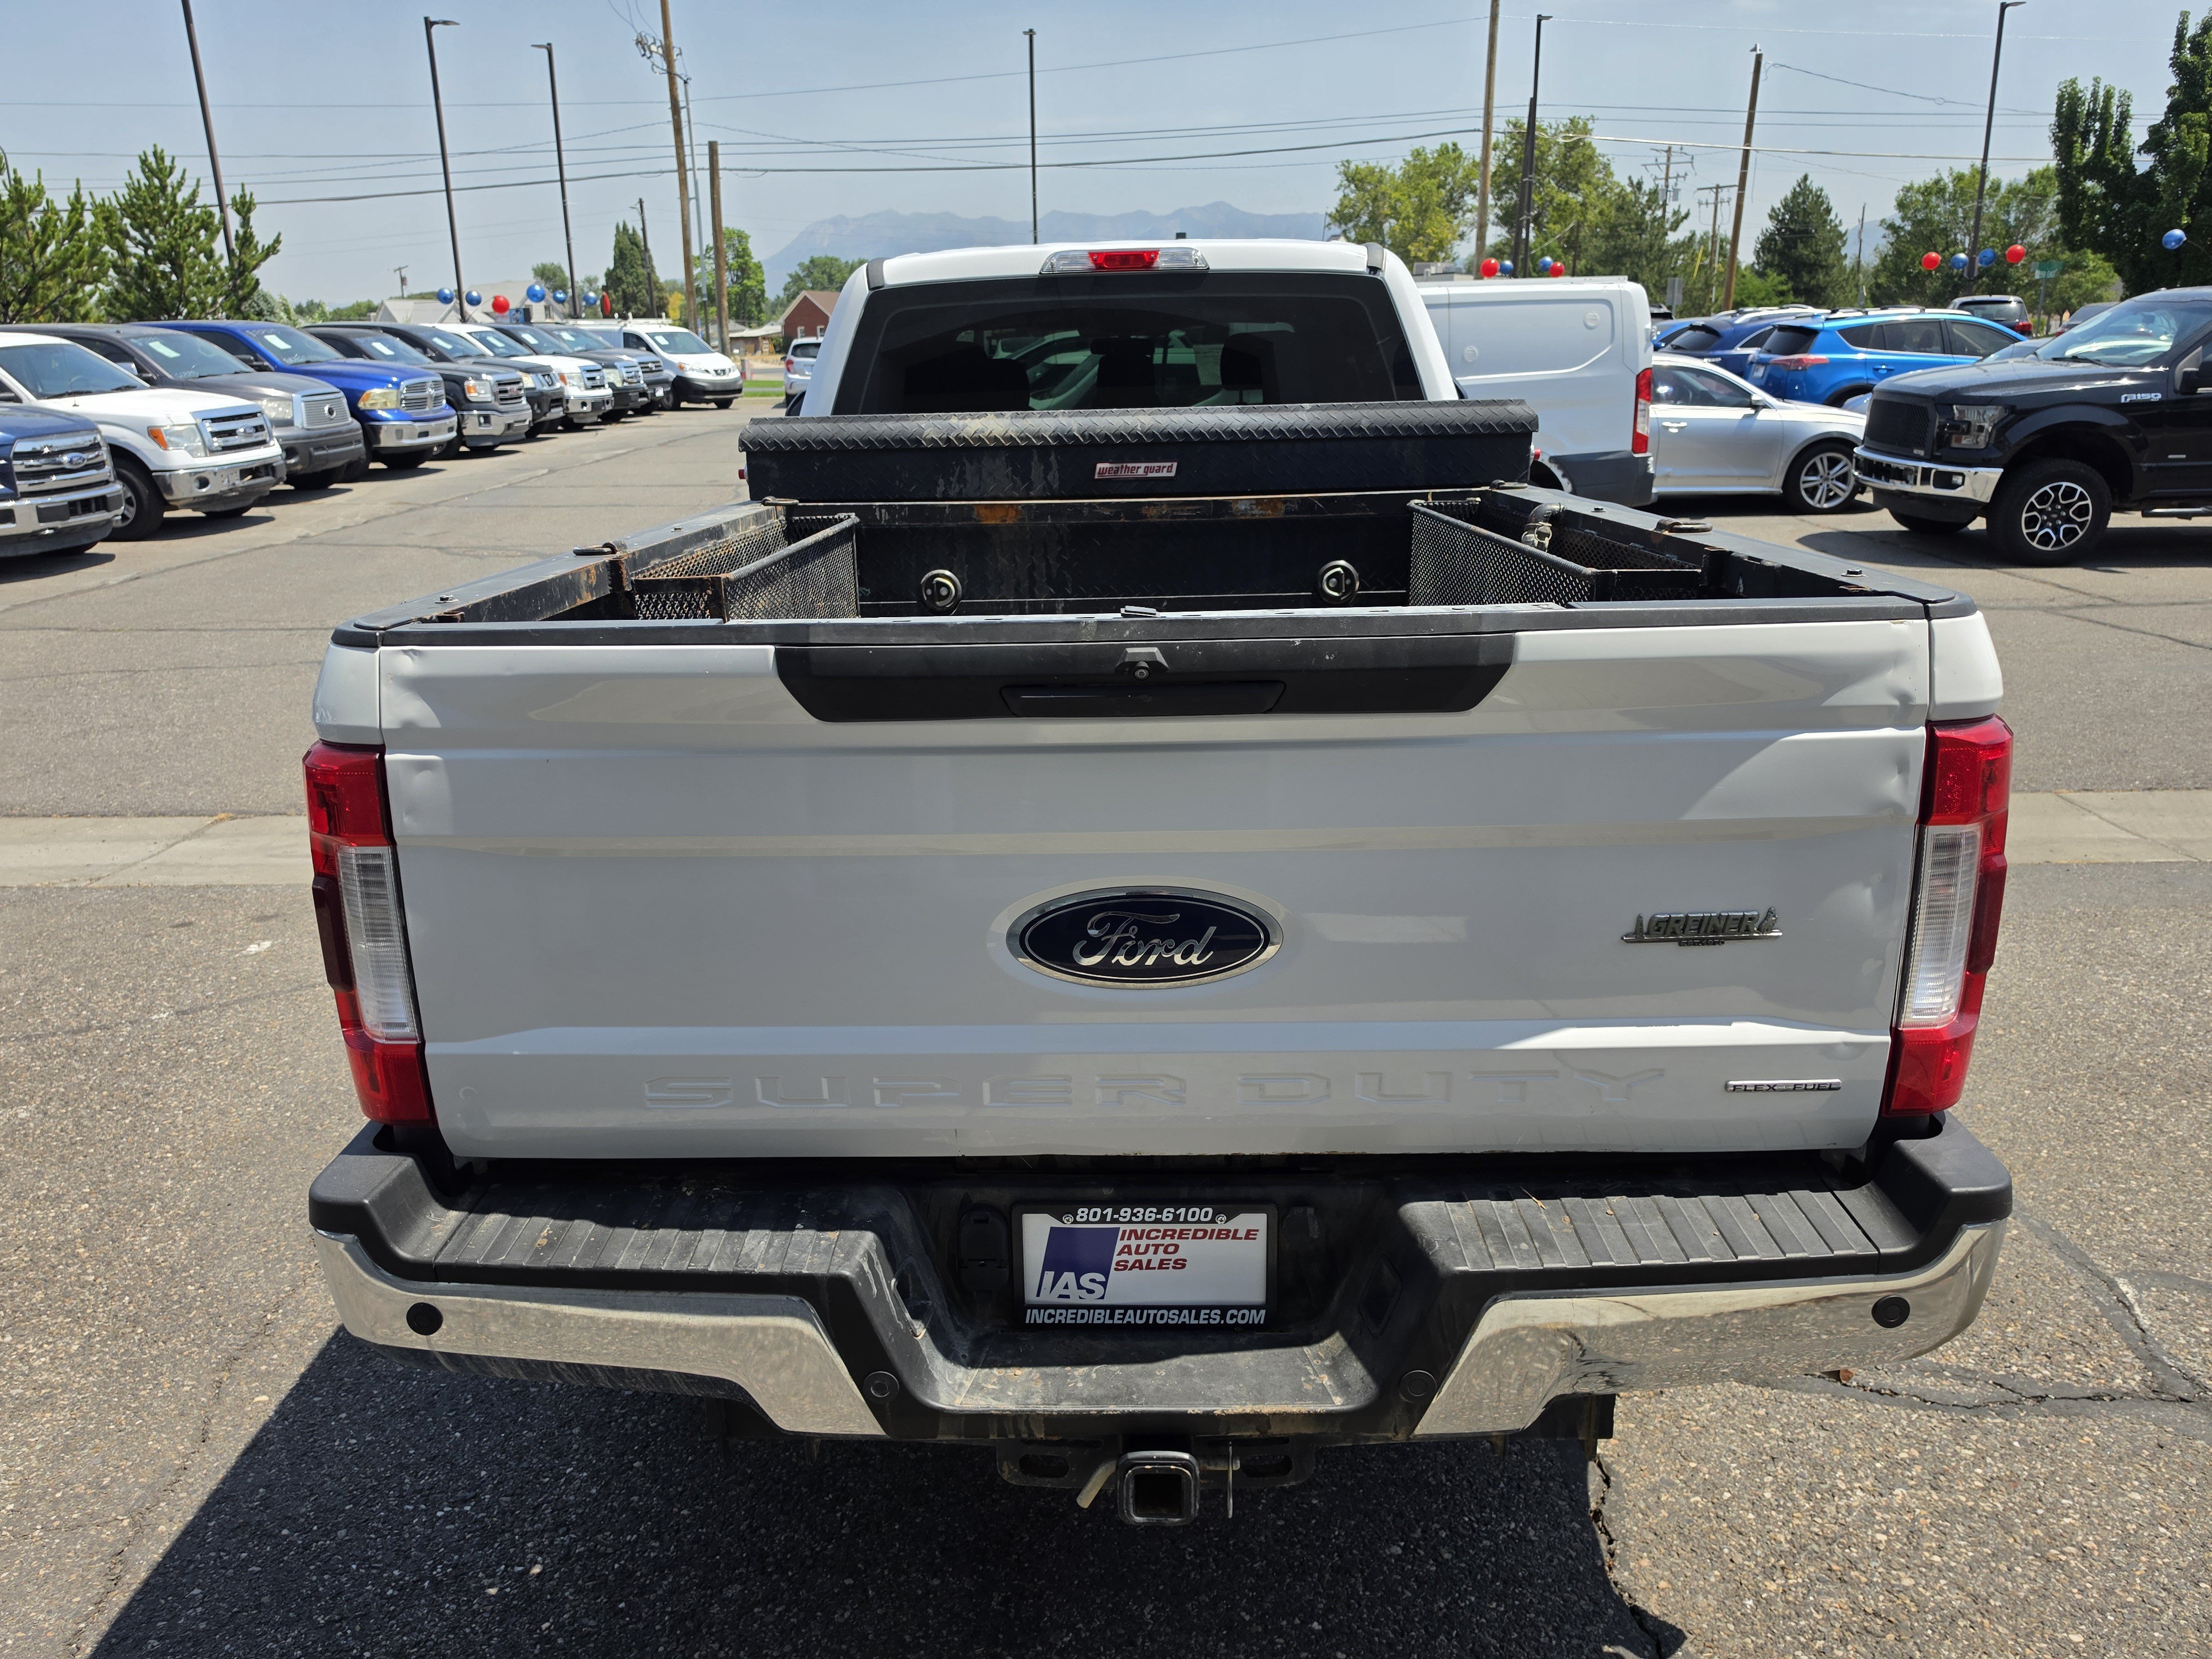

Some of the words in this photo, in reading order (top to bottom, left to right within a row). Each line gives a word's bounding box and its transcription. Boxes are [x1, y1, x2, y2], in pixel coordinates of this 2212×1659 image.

[1098, 464, 1141, 475] weather
[1143, 463, 1173, 474] guard
[1648, 911, 1760, 935] GREINER
[1073, 911, 1217, 966] Ford
[644, 1075, 1187, 1107] SUPER
[1237, 1068, 1665, 1105] DUTY
[1076, 1207, 1213, 1222] 801-936-6100
[1119, 1228, 1260, 1241] INCREDIBLE
[1116, 1243, 1180, 1256] AUTO
[1114, 1259, 1187, 1271] SALES
[1041, 1271, 1106, 1300] IAS
[1025, 1308, 1266, 1324] INCREDIBLEAUTOSALES.COM
